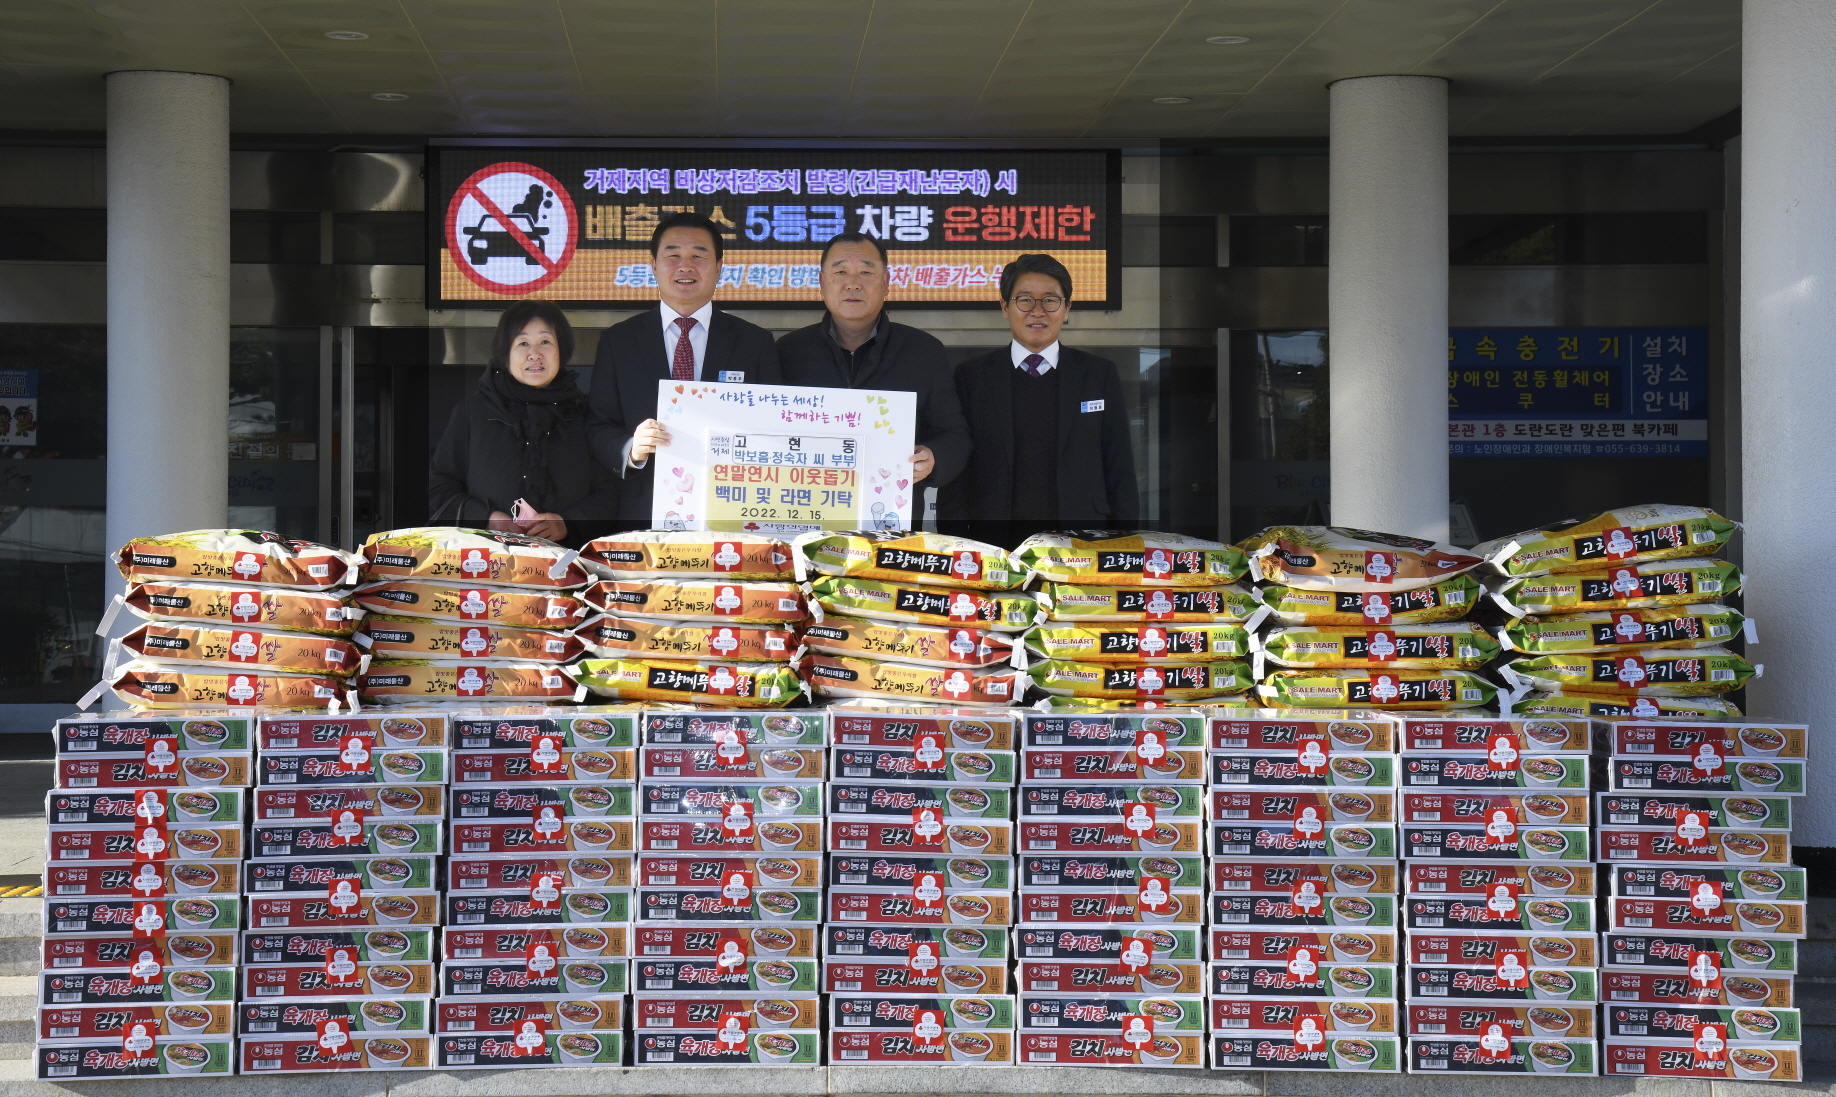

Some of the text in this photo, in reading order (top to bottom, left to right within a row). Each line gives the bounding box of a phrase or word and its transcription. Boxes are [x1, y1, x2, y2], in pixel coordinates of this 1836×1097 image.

[584, 168, 1017, 197] 거제지역 비상저감조치 발령(긴급재난문자) 시
[745, 205, 846, 242] 5등급
[855, 204, 934, 240] 차량
[943, 204, 1096, 242] 운행제한
[746, 263, 786, 288] 확인
[915, 264, 988, 288] 배출가스
[1642, 336, 1688, 358] 설치
[1512, 369, 1609, 389] 전동휠체어
[1642, 364, 1689, 386] 장소
[719, 390, 825, 408] 사랑을 나누는 세상!
[1642, 391, 1689, 412] 안내
[780, 409, 862, 427] 함께하는 기쁨!
[1482, 424, 1507, 437] 1층
[1513, 423, 1574, 437] 도란도란
[1580, 423, 1625, 437] 맞은편
[1632, 423, 1678, 437] 북카페
[710, 447, 730, 456] 거제
[1604, 444, 1681, 454] 055-639-3814
[813, 452, 825, 466] 씨
[831, 454, 855, 467] 부부
[713, 464, 856, 487] 연말연시 이웃돕기
[715, 485, 853, 508] 백미 및 라면 기탁
[741, 507, 825, 520] 2022. 12. 15.
[763, 523, 822, 531] 사랑의열매
[825, 545, 872, 558] SALE MART
[1521, 546, 1570, 560] SALE MART
[657, 556, 710, 570] 고향메뚜기
[843, 588, 891, 599] SALE MART
[1062, 594, 1112, 602] SALE MART
[1525, 585, 1577, 593] SALE MART
[662, 598, 714, 612] 고향메뚜기
[1562, 629, 1587, 637] MART
[649, 638, 701, 652] 고향메뚜기
[862, 637, 915, 654] 고향메뚜기
[1291, 642, 1314, 650] SALE
[871, 678, 924, 694] 고향메뚜기
[79, 725, 150, 744] 농심 육개장
[312, 723, 348, 742] 김치
[495, 722, 539, 741] 육개장
[852, 722, 919, 740] 농심 김치
[1068, 720, 1111, 739] 육개장
[1261, 725, 1296, 744] 김치
[1455, 725, 1490, 743] 김치
[1074, 755, 1109, 774] 김치
[1420, 761, 1439, 772] 농심
[1444, 760, 1488, 780] 육개장
[309, 793, 345, 812] 김치
[871, 789, 915, 808] 육개장
[1070, 827, 1105, 846] 김치
[289, 864, 334, 884] 육개장
[501, 862, 536, 882] 김치
[689, 862, 726, 881] 김치
[1063, 860, 1107, 879] 육개장
[684, 932, 720, 951] 김치
[869, 930, 912, 949] 육개장
[1462, 939, 1497, 958] 김치
[88, 975, 133, 995] 육개장
[875, 966, 910, 986] 김치
[1653, 978, 1690, 997] 김치
[94, 1011, 132, 1031] 김치
[283, 1004, 328, 1024] 육개장
[489, 1005, 525, 1025] 김치
[1063, 1003, 1107, 1022] 육개장
[1628, 1011, 1699, 1030] 농심 육개장
[1256, 1042, 1299, 1061] 육개장
